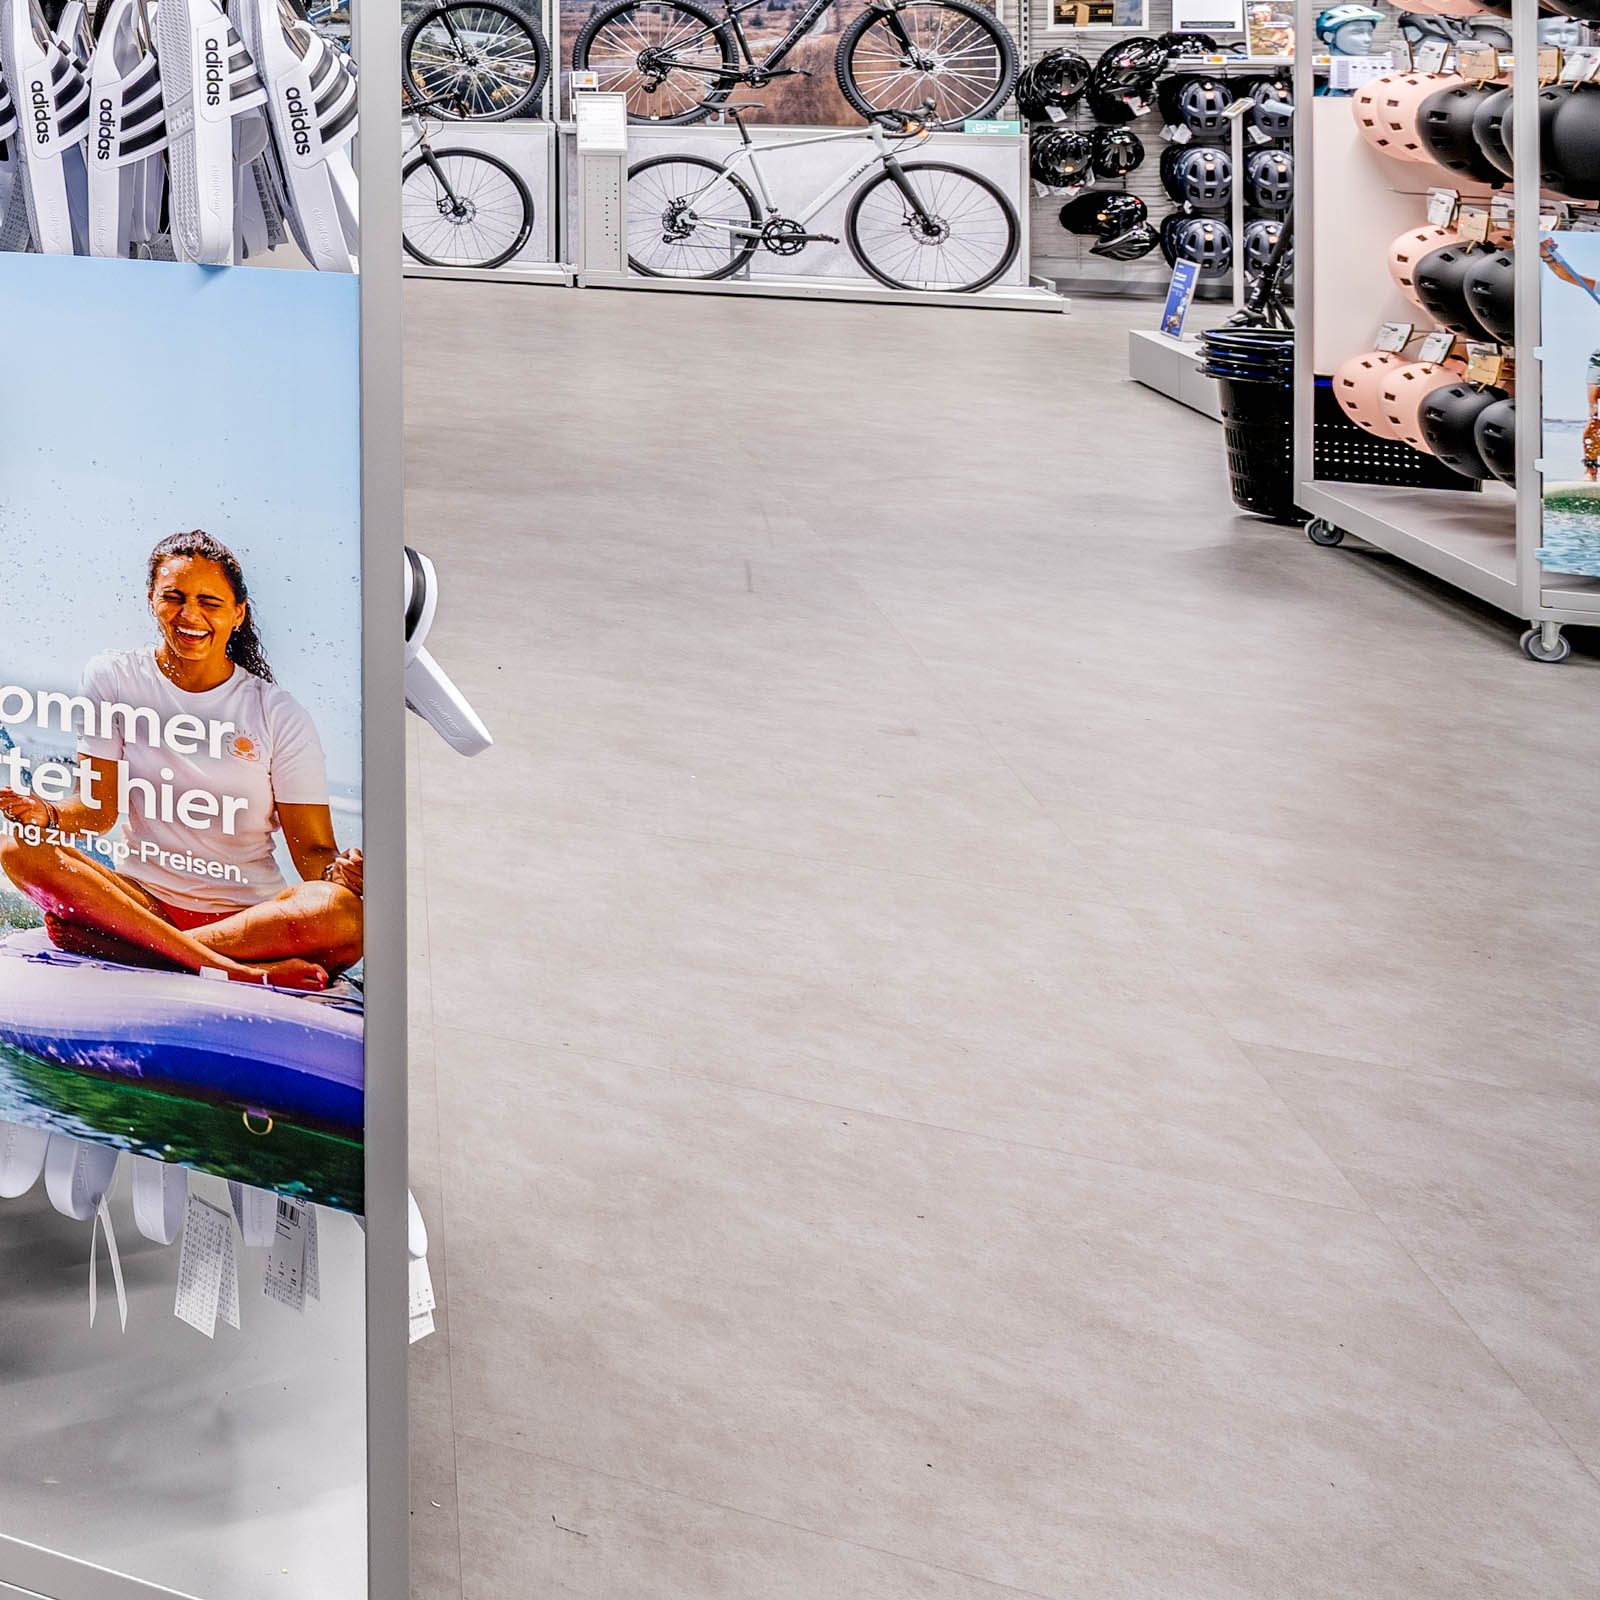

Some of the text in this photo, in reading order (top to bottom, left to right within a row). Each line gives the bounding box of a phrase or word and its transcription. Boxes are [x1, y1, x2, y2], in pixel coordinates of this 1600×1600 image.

[205, 37, 224, 106] adidas
[31, 80, 51, 145] adidas
[97, 98, 115, 161] adidas
[285, 86, 311, 156] adidas
[115, 760, 250, 836] hier
[46, 824, 76, 849] zu
[80, 828, 250, 885] Top-Preisen.
